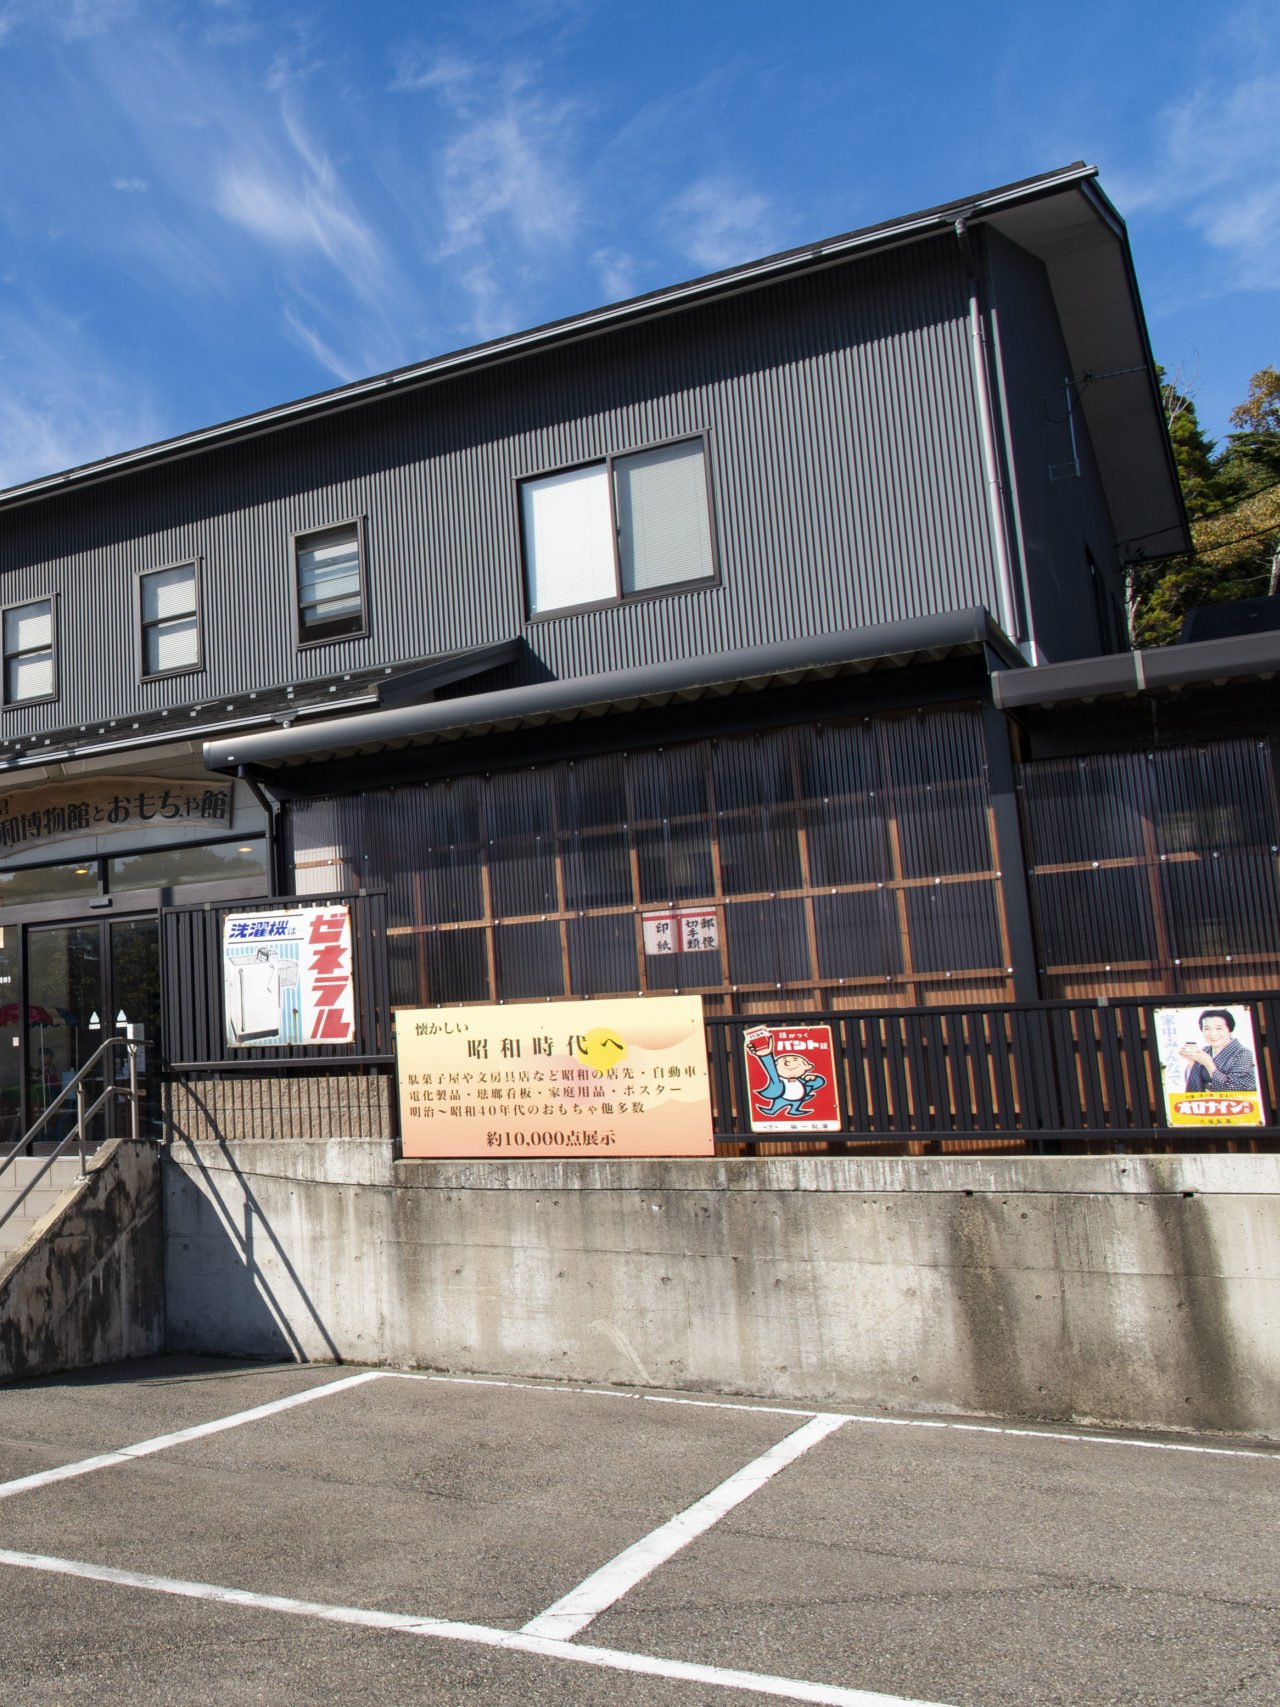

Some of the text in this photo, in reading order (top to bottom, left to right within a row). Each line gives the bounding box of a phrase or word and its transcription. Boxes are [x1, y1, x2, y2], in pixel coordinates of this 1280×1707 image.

[229, 920, 296, 939] 洗濯機は
[656, 922, 671, 951] 印紙
[685, 920, 701, 949] 切手類
[700, 918, 715, 948] 郵便
[308, 913, 351, 1039] ゼネラル
[415, 1022, 469, 1036] 懐かしい
[467, 1035, 624, 1059] 昭和時代へ
[486, 1129, 616, 1147] 約10,000点展示
